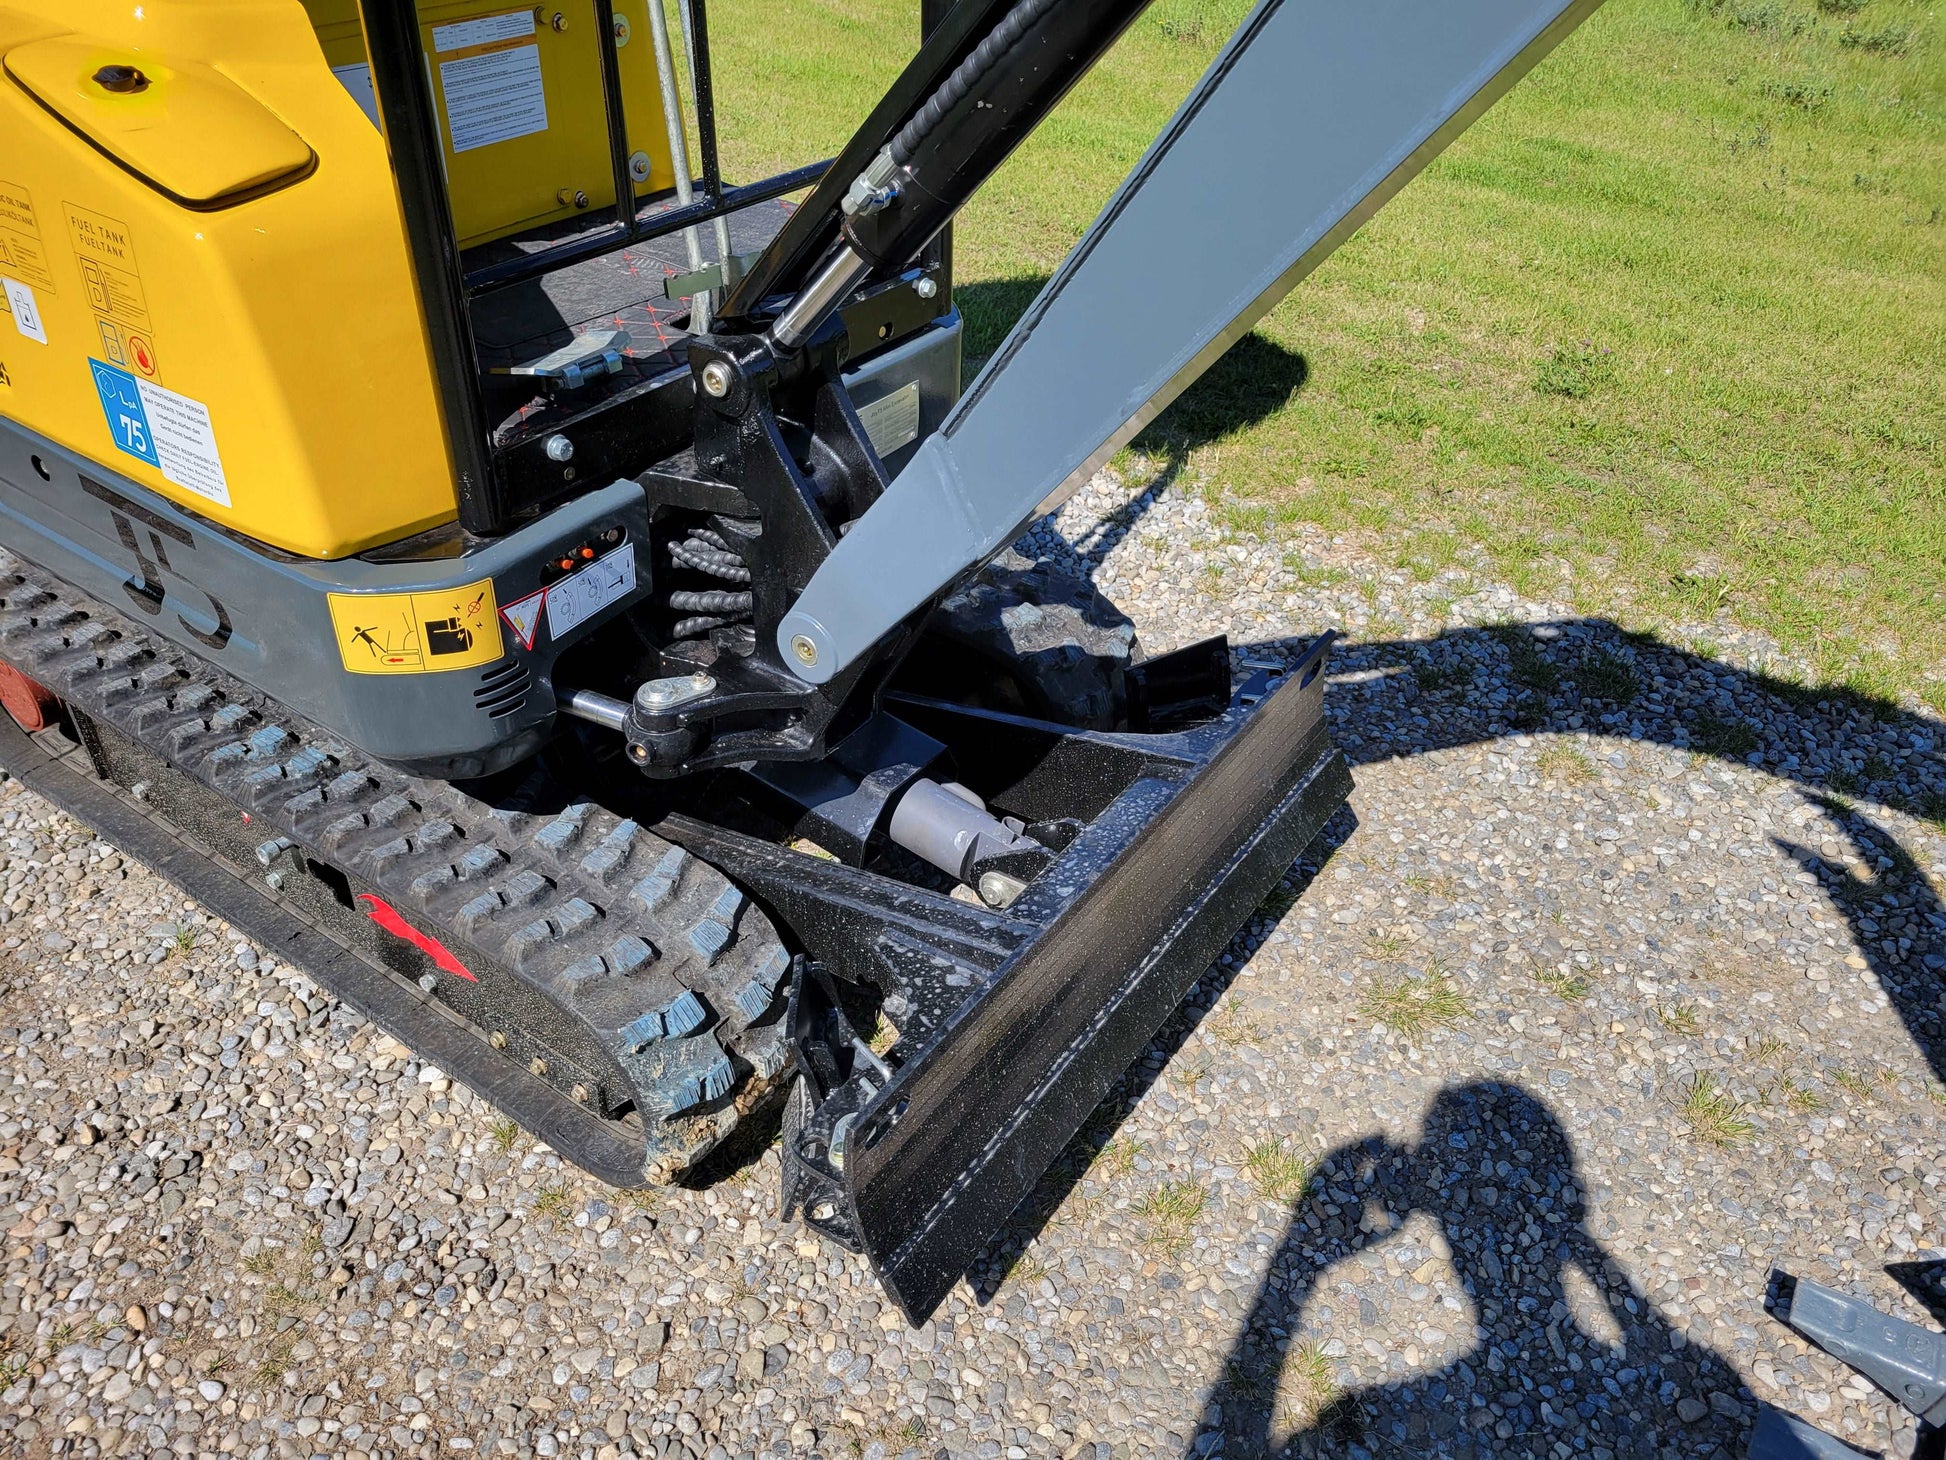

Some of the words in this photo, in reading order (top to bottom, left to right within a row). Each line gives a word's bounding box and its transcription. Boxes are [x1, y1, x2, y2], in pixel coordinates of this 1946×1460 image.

[71, 215, 96, 235] FUEL
[98, 225, 126, 246] TANK
[79, 233, 126, 260] FUELTANK
[119, 413, 147, 453] 75
